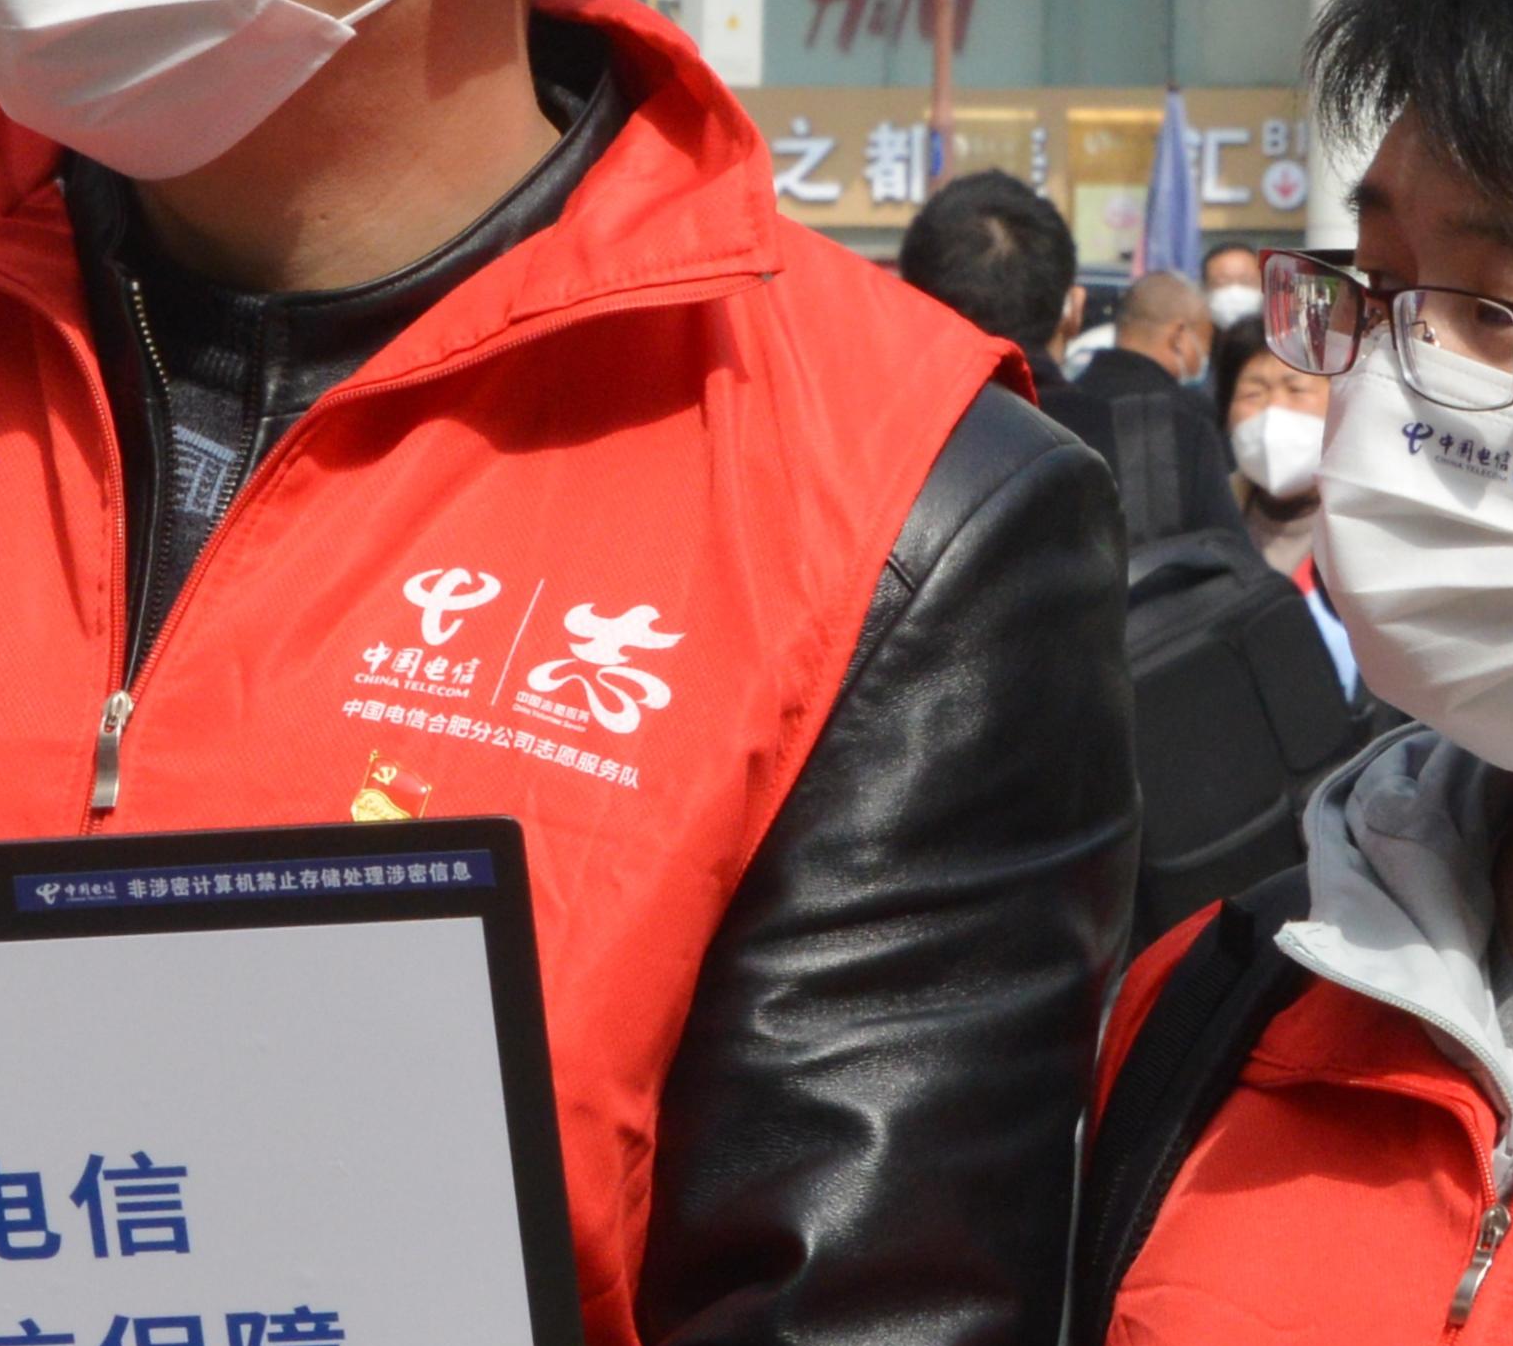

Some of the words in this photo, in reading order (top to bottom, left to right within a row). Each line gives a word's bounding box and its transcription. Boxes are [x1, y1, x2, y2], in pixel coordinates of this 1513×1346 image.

[1439, 434, 1510, 471] 中国电信
[362, 642, 482, 685] 中国电信
[354, 673, 400, 689] CHINA
[403, 679, 470, 699] TELECOM
[341, 698, 641, 790] 中国电信合肥分公司志愿服务队
[128, 861, 472, 899] 非涉密计算机禁止存储处理涉密信息
